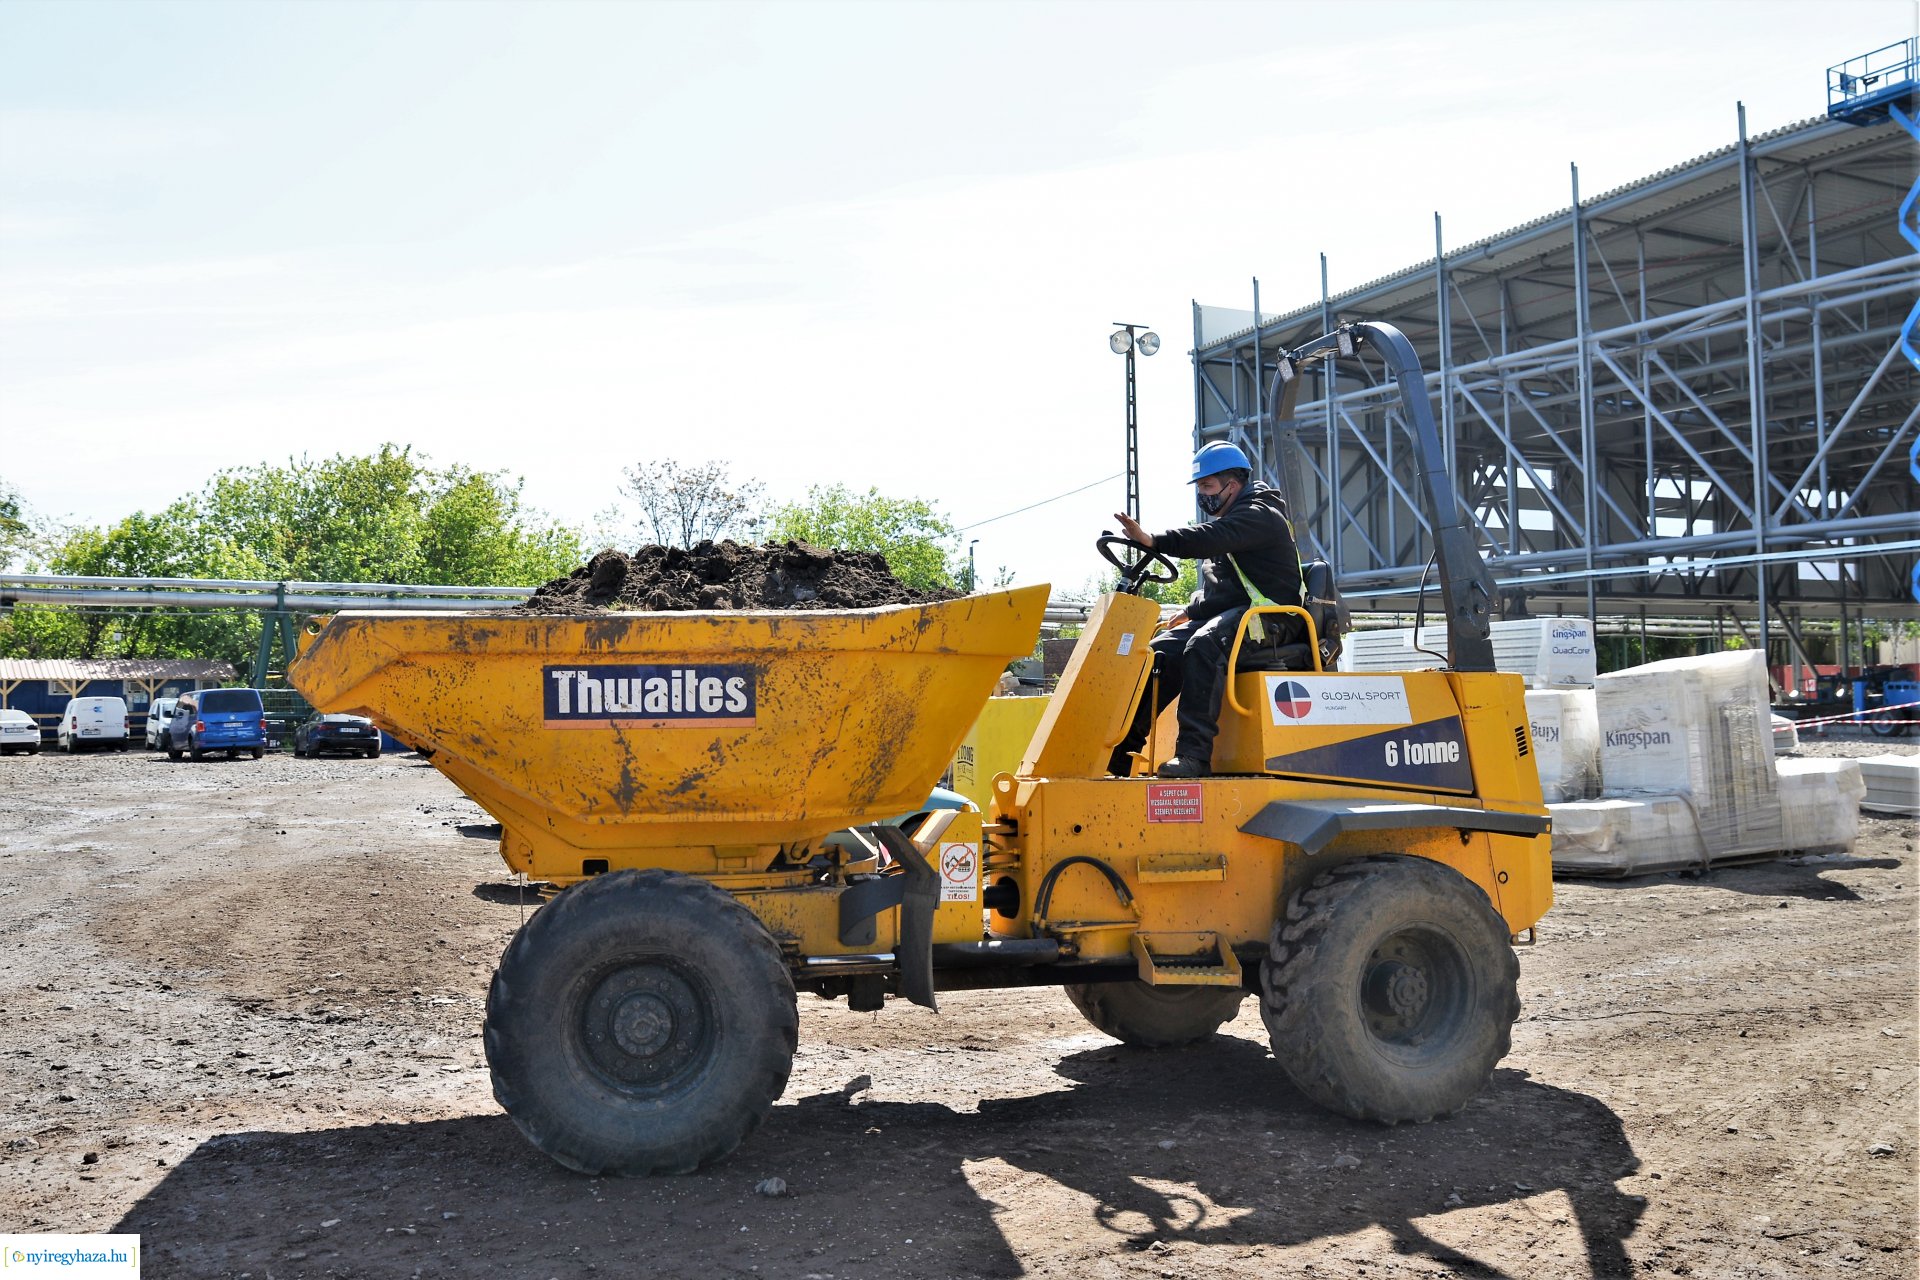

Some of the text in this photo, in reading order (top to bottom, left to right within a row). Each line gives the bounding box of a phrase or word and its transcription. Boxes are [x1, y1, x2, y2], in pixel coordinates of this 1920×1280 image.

[1552, 646, 1590, 655] QuadCore
[551, 669, 748, 714] Thwaites
[1605, 730, 1671, 750] Kingspan
[1384, 739, 1460, 767] 6 tonne
